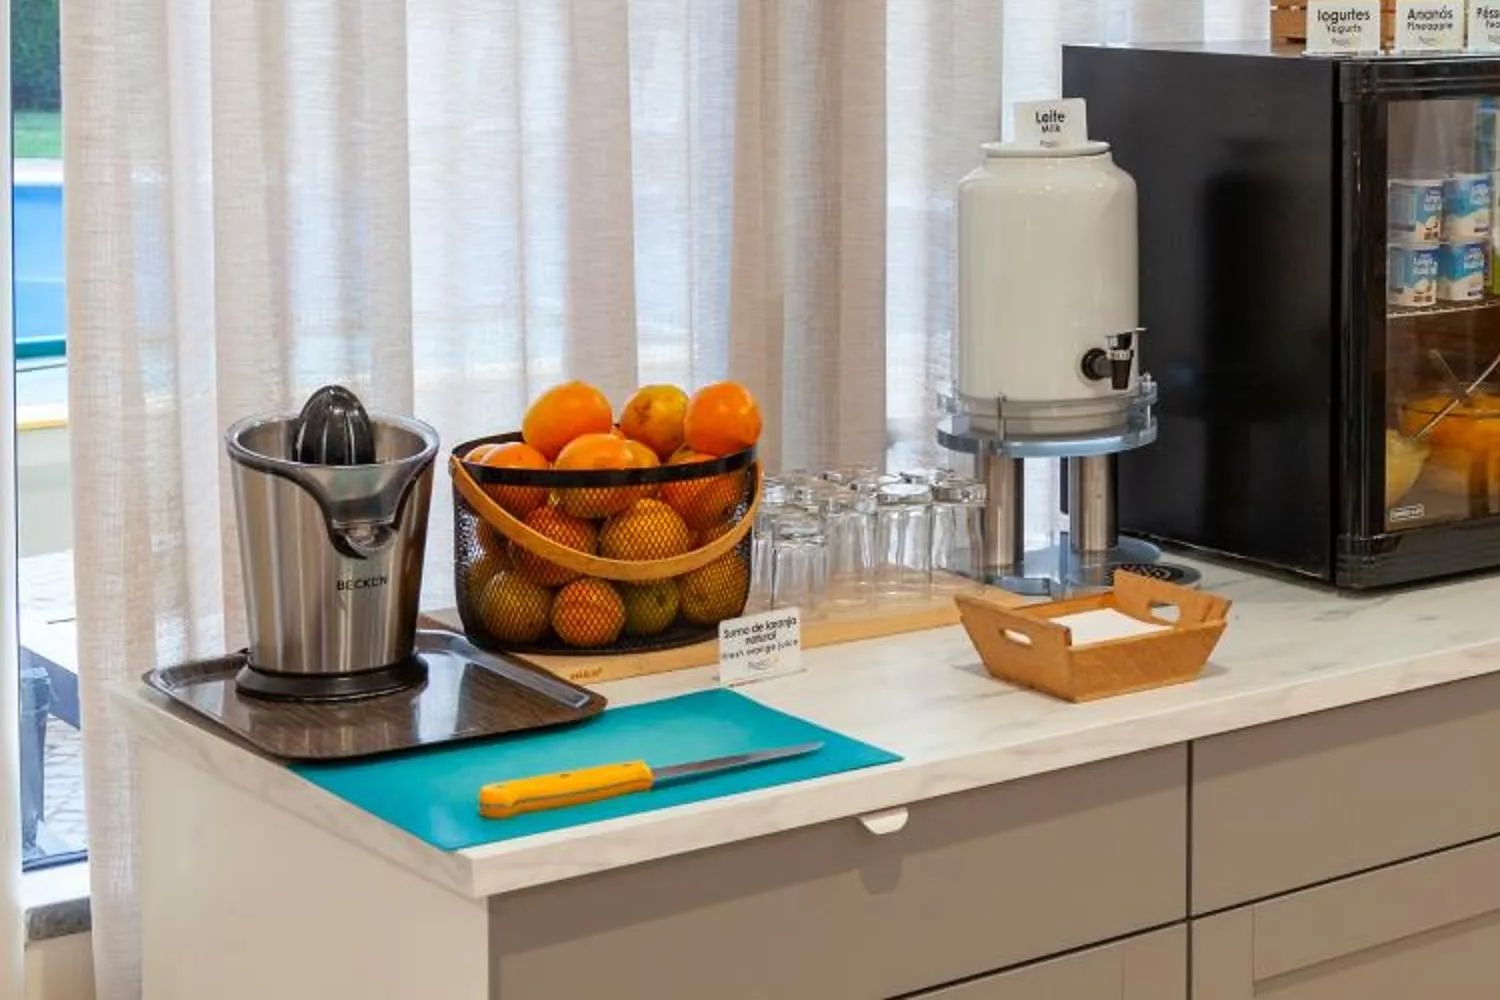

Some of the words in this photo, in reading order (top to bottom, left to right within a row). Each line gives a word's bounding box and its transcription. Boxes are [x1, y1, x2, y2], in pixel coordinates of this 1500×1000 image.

[1317, 8, 1371, 24] Iogurtes
[1035, 109, 1065, 124] Leite
[336, 576, 388, 591] BECKEN
[723, 627, 750, 639] Sumo
[751, 622, 764, 634] de
[765, 616, 797, 630] laranja
[745, 630, 777, 645] natural
